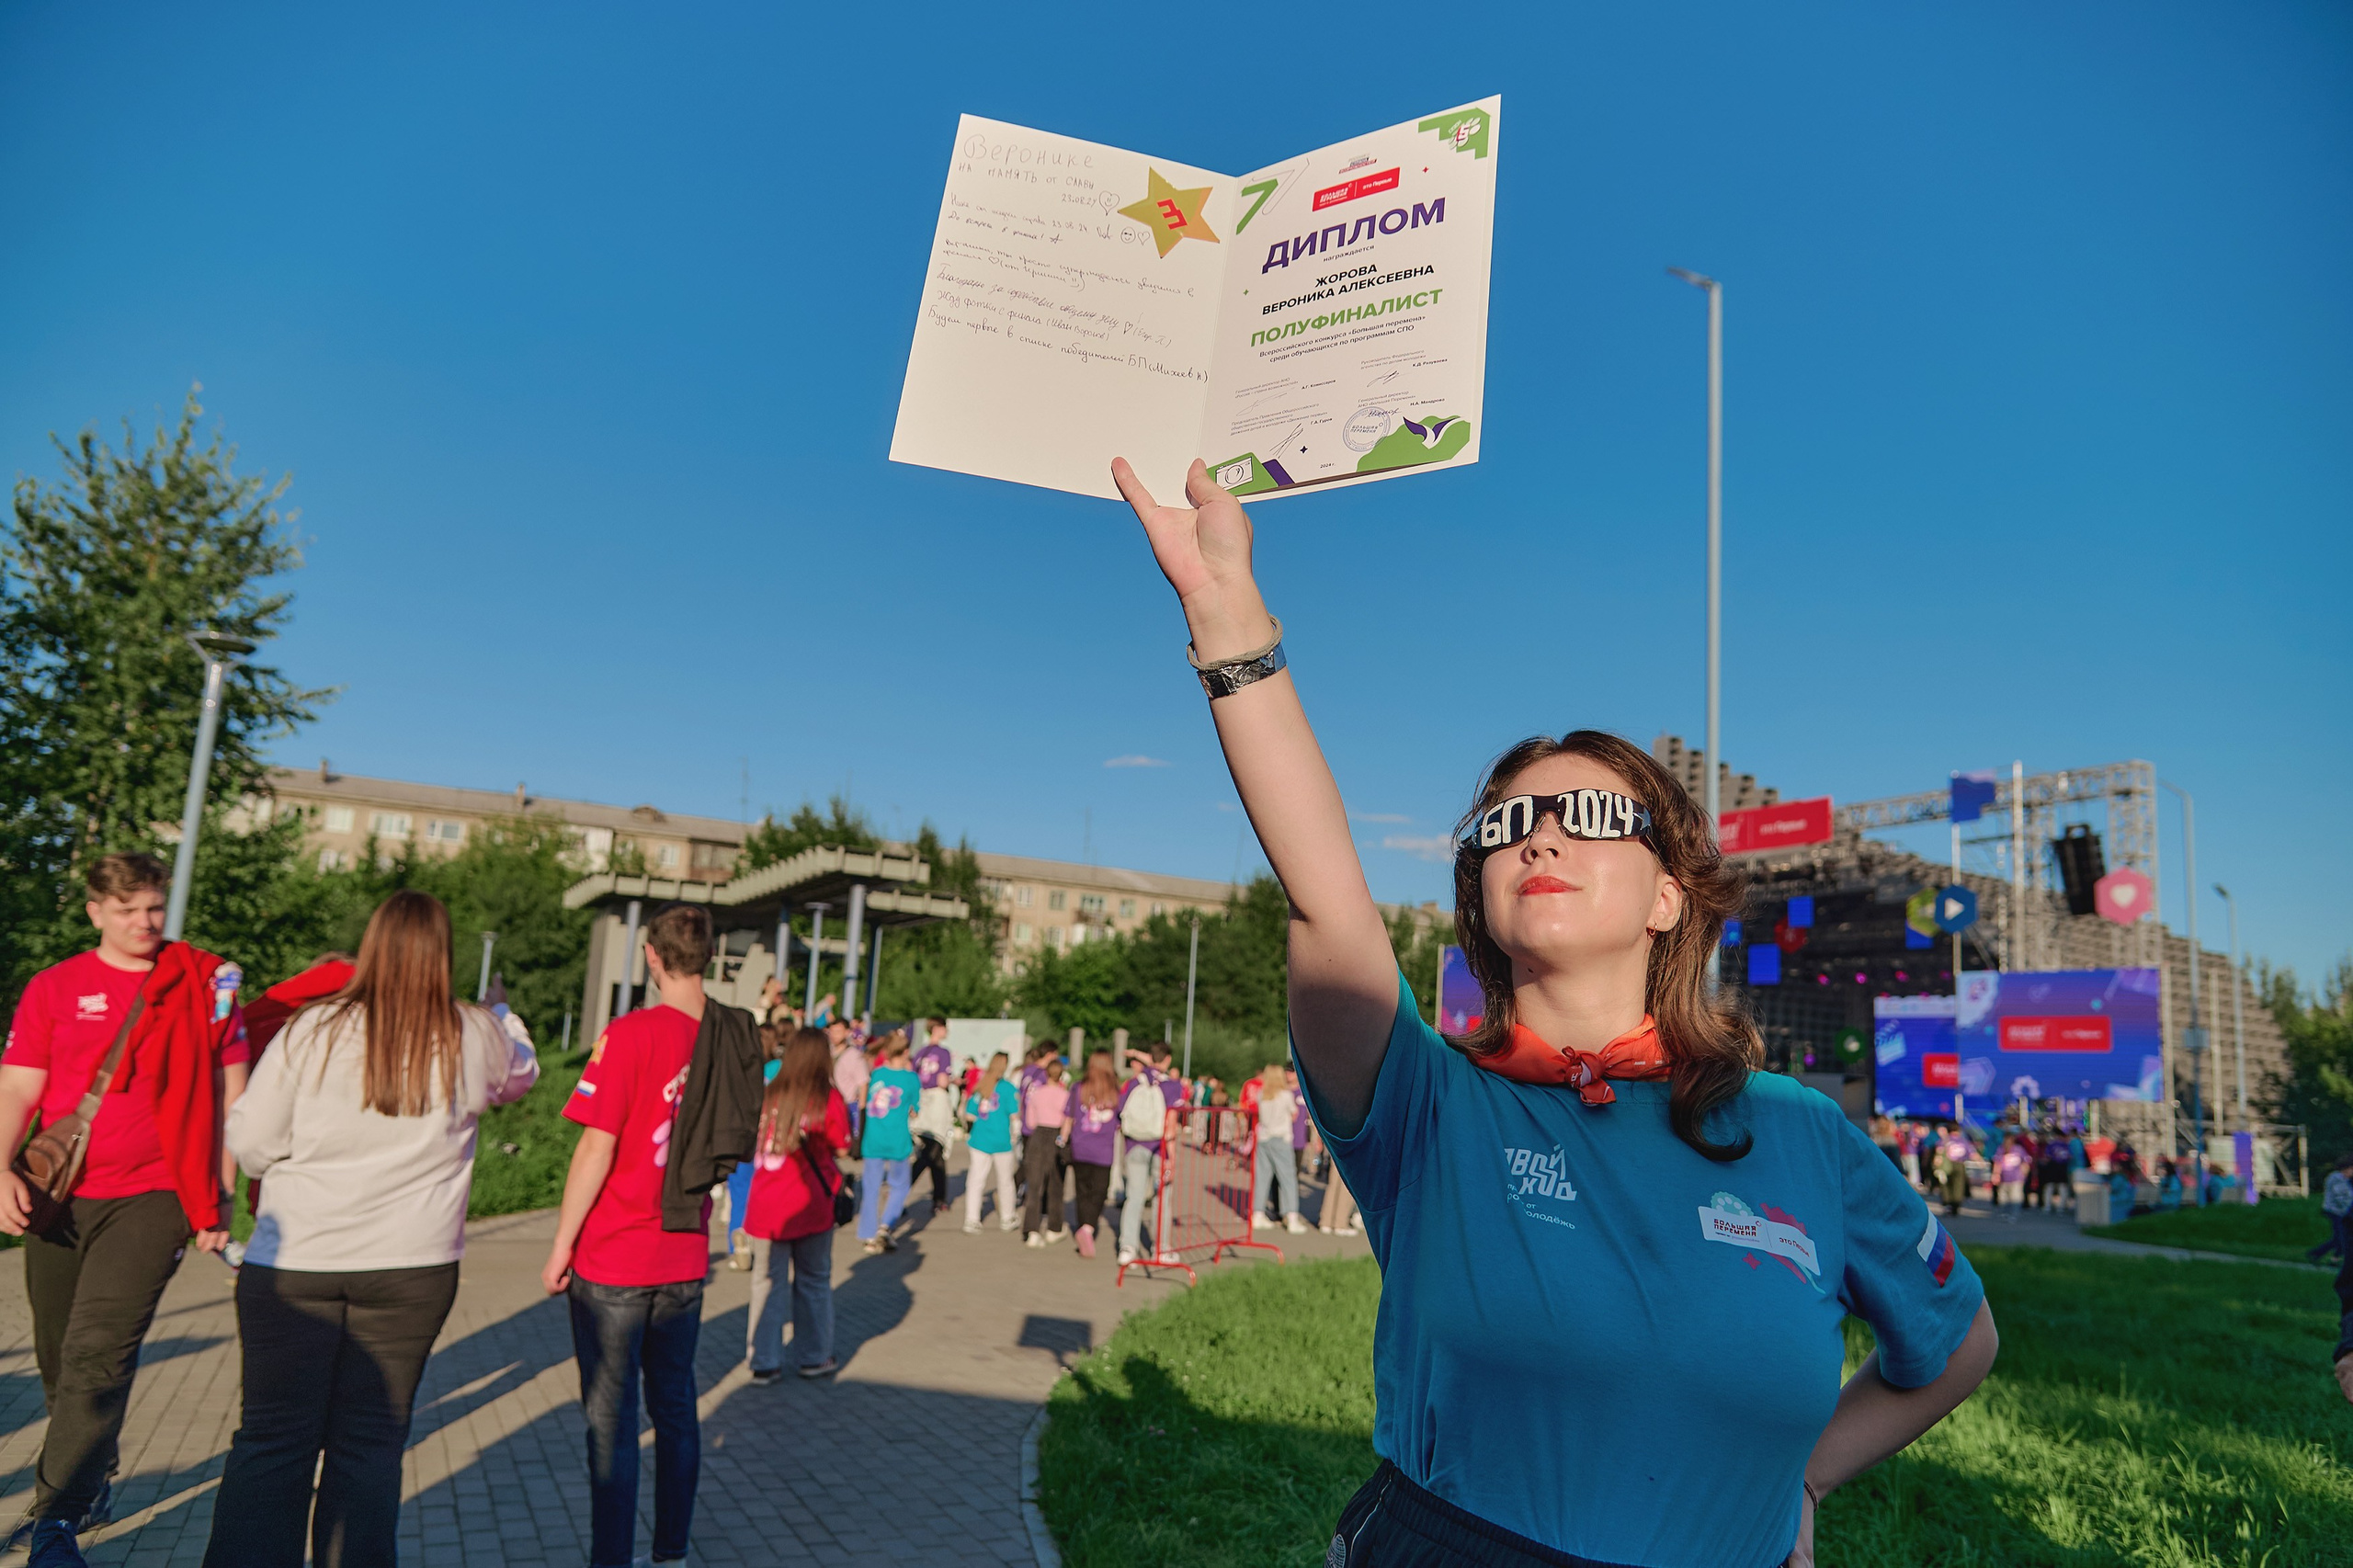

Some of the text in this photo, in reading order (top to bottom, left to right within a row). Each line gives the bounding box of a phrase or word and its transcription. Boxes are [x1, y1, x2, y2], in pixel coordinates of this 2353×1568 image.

[964, 133, 1094, 168] Веронике
[959, 162, 972, 173] НА
[988, 168, 1038, 184] ПАМЯТЬ
[1065, 176, 1095, 190] СЛАВЫ
[1062, 193, 1097, 208] 23.08.24
[1261, 197, 1446, 275] ДИПЛОМ
[1323, 244, 1375, 263] награждается
[937, 263, 985, 290] Благодарю
[989, 284, 1004, 296] за
[1262, 264, 1434, 315] ВЕРОНИКА АЛЕКСЕЕВНА
[1315, 264, 1377, 287] ЖОРОВА
[937, 290, 961, 308] Жду
[927, 304, 961, 327] Будем
[1006, 324, 1014, 338] в
[1019, 333, 1053, 349] списке
[1061, 342, 1125, 363] победителей
[1250, 289, 1443, 347] ПОЛУФИНАЛИСТ
[1259, 315, 1426, 358] Всероссийского конкурса «Большая перемена»
[1269, 352, 1290, 363] среди
[1290, 342, 1338, 358] обучающихся
[1349, 328, 1395, 344] программам
[1396, 324, 1415, 334] СПО
[1557, 789, 1634, 838] 2024
[1713, 1218, 1756, 1232] БОЛЬШАЯ
[1713, 1224, 1756, 1237] ПЕРЕМЕНА
